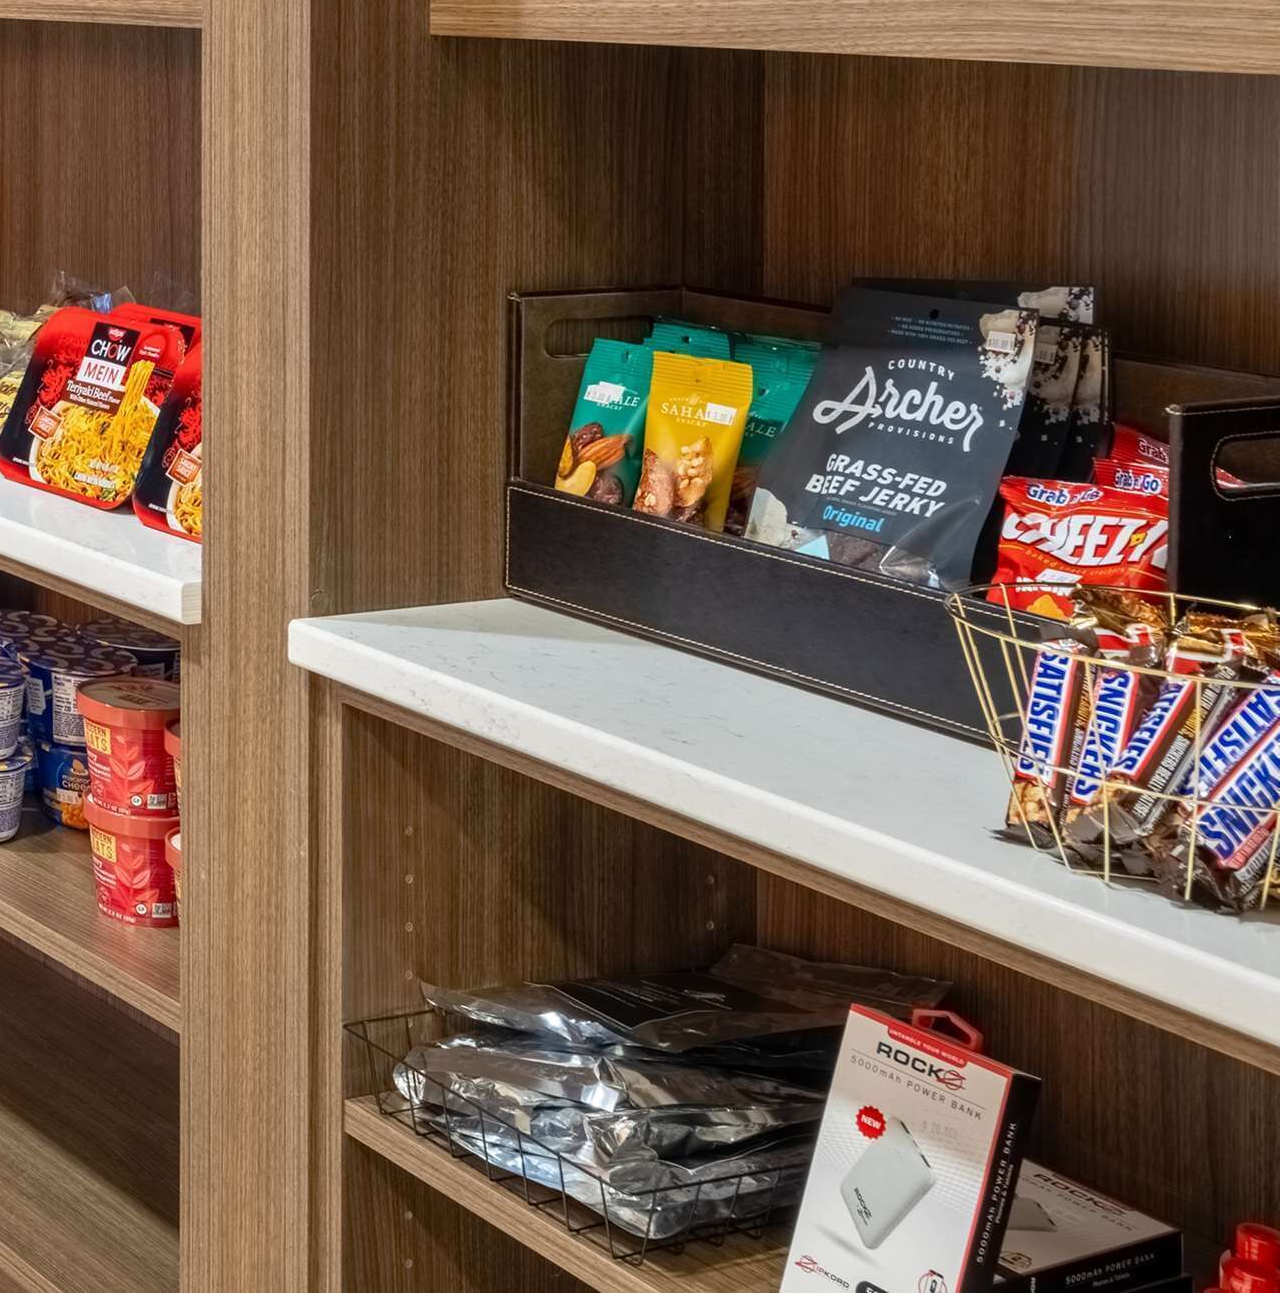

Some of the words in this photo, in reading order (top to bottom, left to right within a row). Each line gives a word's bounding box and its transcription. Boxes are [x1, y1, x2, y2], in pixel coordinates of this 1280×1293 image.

[91, 338, 131, 362] CHOW
[83, 361, 119, 385] MEIN
[888, 358, 956, 382] COUNTRY
[66, 379, 94, 398] Teriyaki
[93, 385, 111, 401] Beef
[660, 402, 706, 420] SAHA
[812, 365, 985, 453] Archer
[868, 421, 955, 446] PROVISIONS
[826, 453, 948, 498] GRASS-FED
[1142, 474, 1161, 495] Go
[804, 473, 861, 496] BEEF
[859, 486, 946, 519] JERKY
[1028, 483, 1070, 506] Grab
[822, 504, 885, 534] Original
[1024, 549, 1058, 568] baked
[1073, 671, 1131, 799] SNICKERS
[1160, 734, 1192, 770] SNICKERS
[1147, 765, 1171, 794] REALLY
[888, 1027, 922, 1047] UNTANGLE
[941, 1050, 965, 1065] WORLD
[851, 1054, 902, 1084] 5000mAh
[906, 1080, 946, 1104] POWER
[951, 1099, 982, 1121] BANK
[860, 1112, 883, 1131] NEW
[976, 1211, 994, 1264] 5000mAh
[992, 1153, 1008, 1202] POWER
[1005, 1121, 1017, 1150] BANK
[1065, 1267, 1103, 1286] 5000mAh
[1105, 1258, 1133, 1273] POWER
